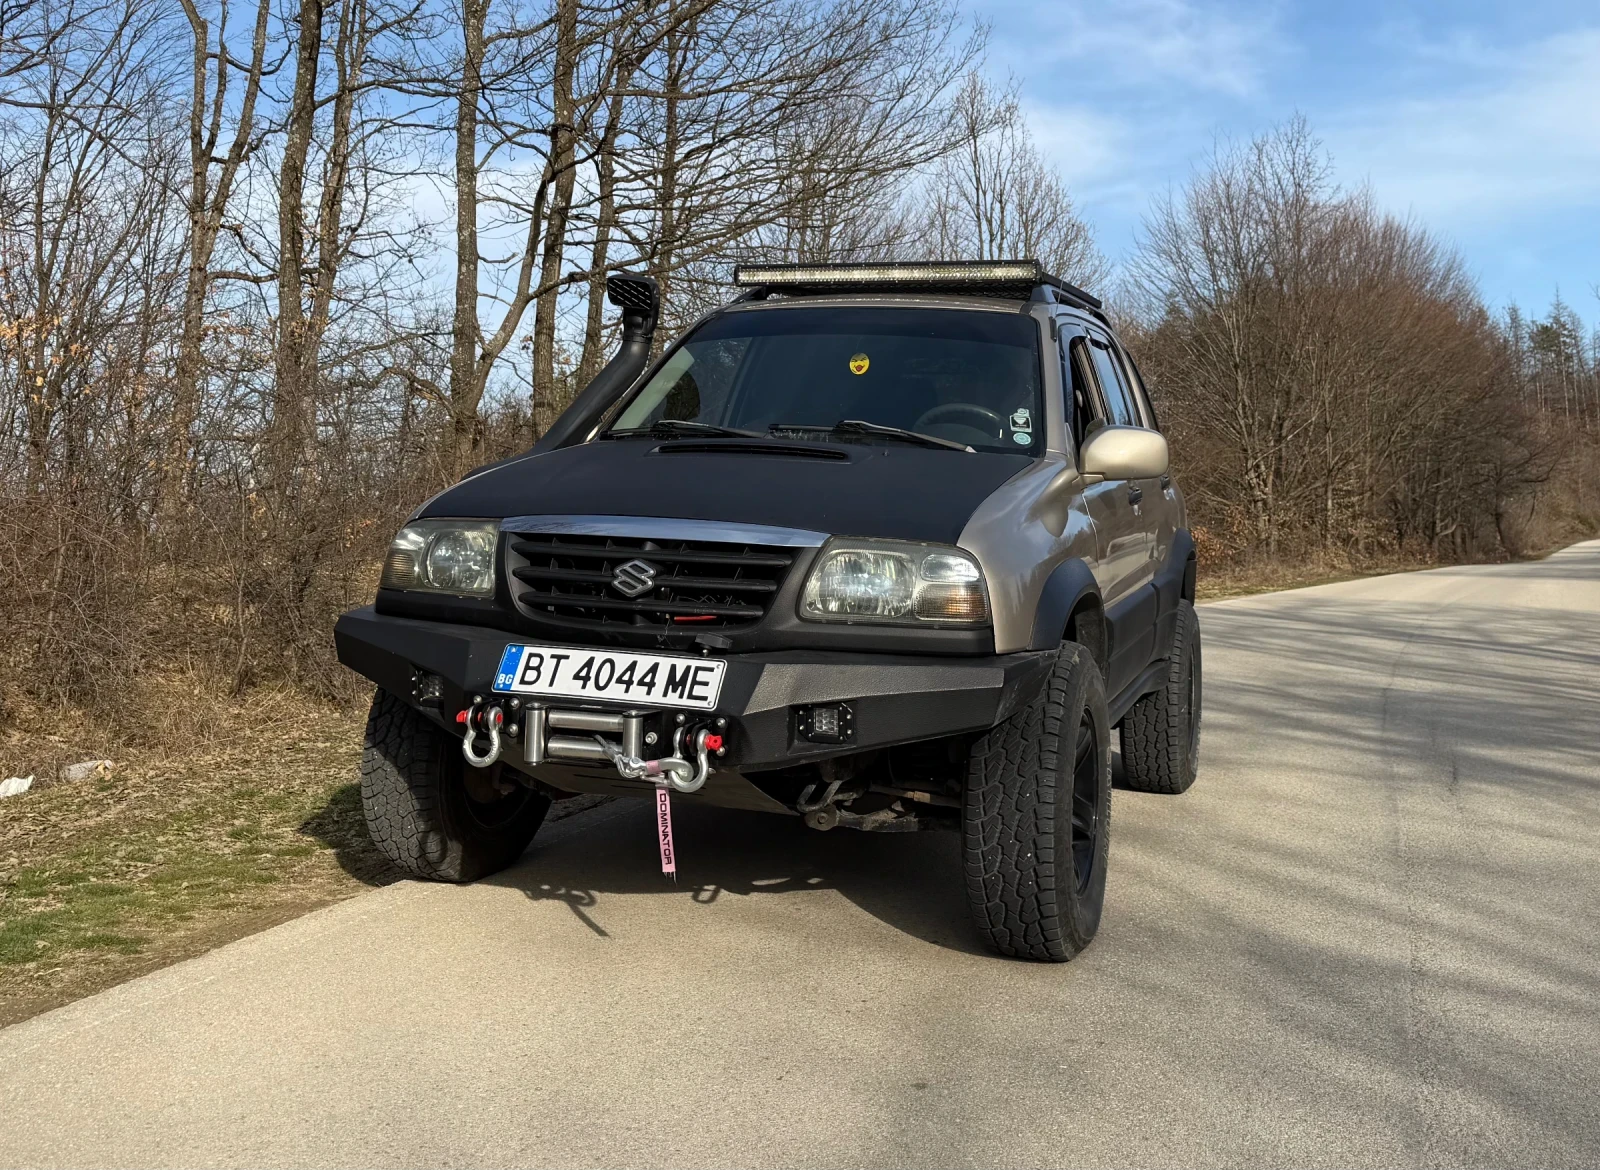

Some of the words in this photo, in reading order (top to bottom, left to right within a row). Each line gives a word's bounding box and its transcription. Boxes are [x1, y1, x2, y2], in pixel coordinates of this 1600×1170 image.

[498, 673, 513, 684] BG
[519, 652, 571, 687] BT
[572, 656, 660, 696] 4044
[662, 663, 715, 702] ME
[660, 793, 672, 865] DOMINATOR
